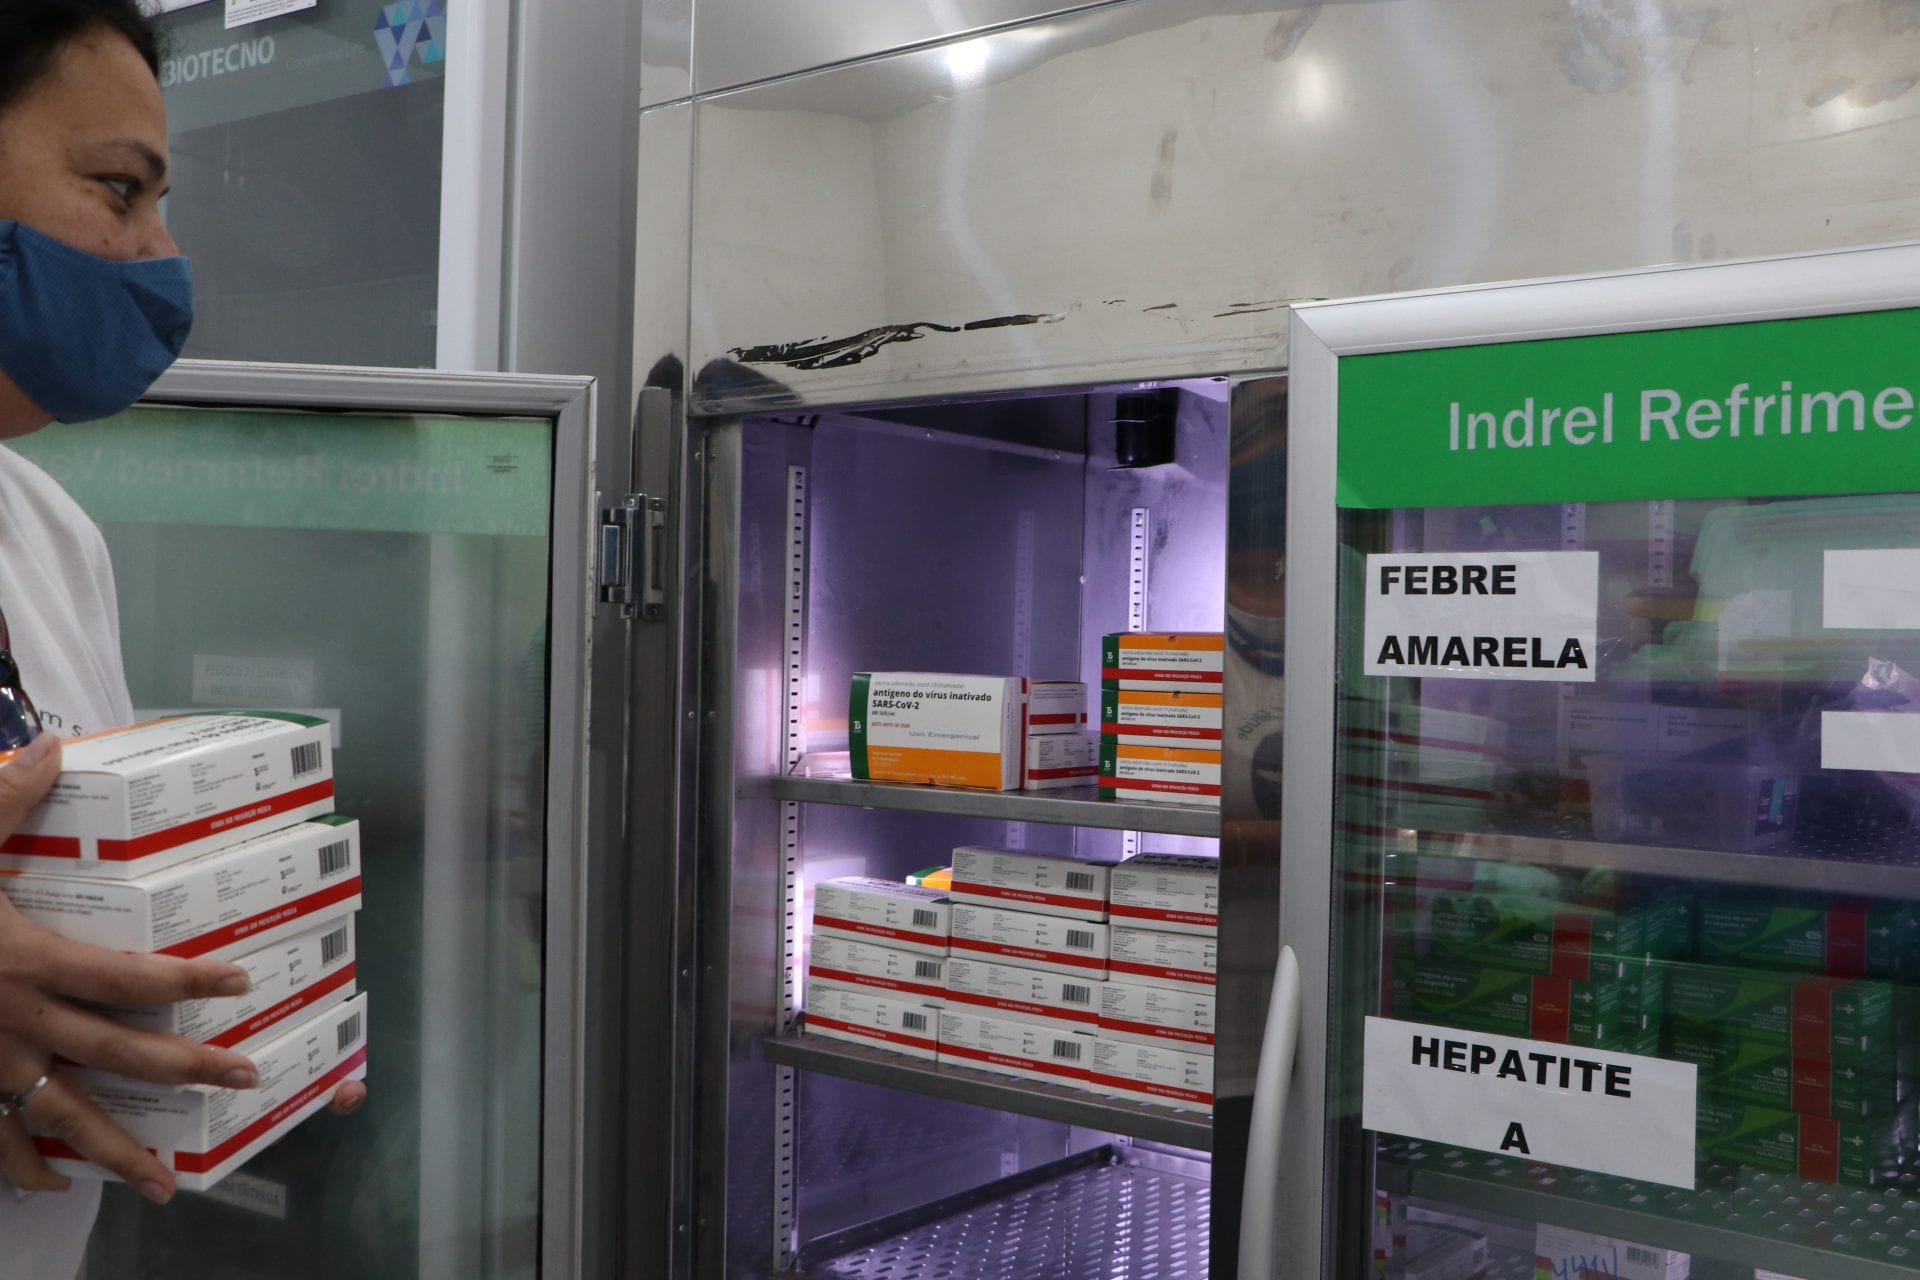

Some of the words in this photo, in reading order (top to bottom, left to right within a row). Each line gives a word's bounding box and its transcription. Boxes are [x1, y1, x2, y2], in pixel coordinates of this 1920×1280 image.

[1448, 392, 1613, 451] Indrel
[1640, 380, 1920, 442] Refrime
[1379, 563, 1517, 596] FEBRE
[1376, 634, 1588, 669] AMARELA
[872, 699, 920, 710] SARS-CoV-2
[873, 688, 911, 699] antígeno
[912, 690, 924, 699] do
[926, 689, 948, 700] vírus
[949, 690, 992, 702] inativado
[909, 730, 926, 738] Uso
[928, 731, 980, 741] Emergencial
[1411, 1034, 1632, 1099] HEPATITE
[1500, 1122, 1530, 1155] A
